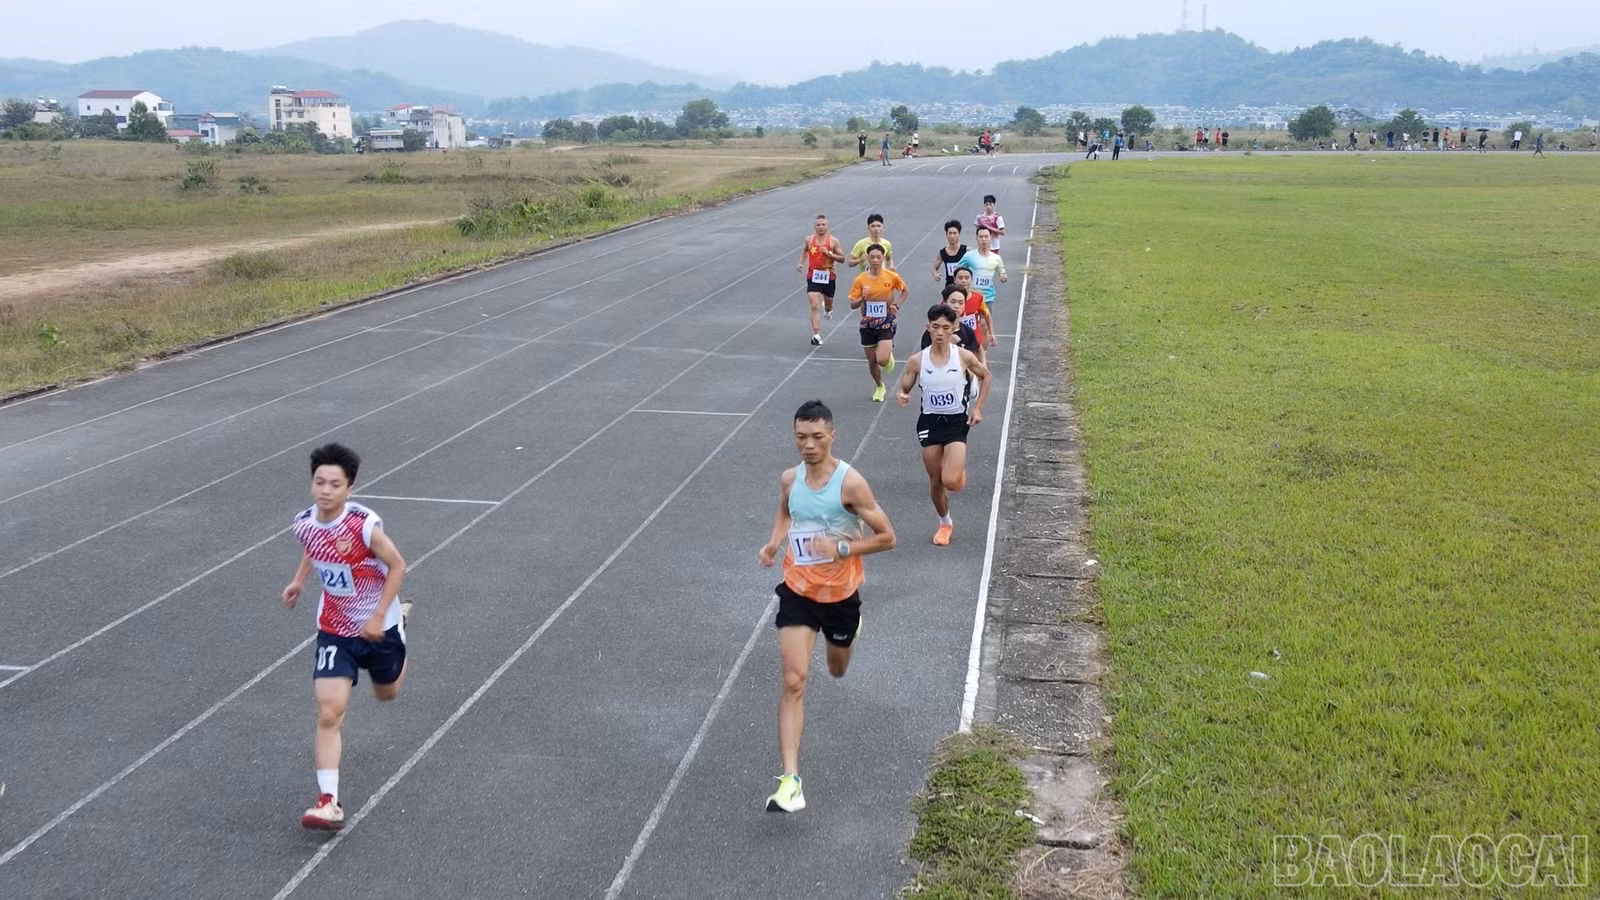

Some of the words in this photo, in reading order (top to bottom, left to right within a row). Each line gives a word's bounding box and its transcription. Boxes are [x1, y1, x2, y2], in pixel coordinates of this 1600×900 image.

[814, 272, 828, 281] 244
[974, 277, 990, 287] 129
[869, 304, 885, 314] 107
[930, 392, 954, 407] 039
